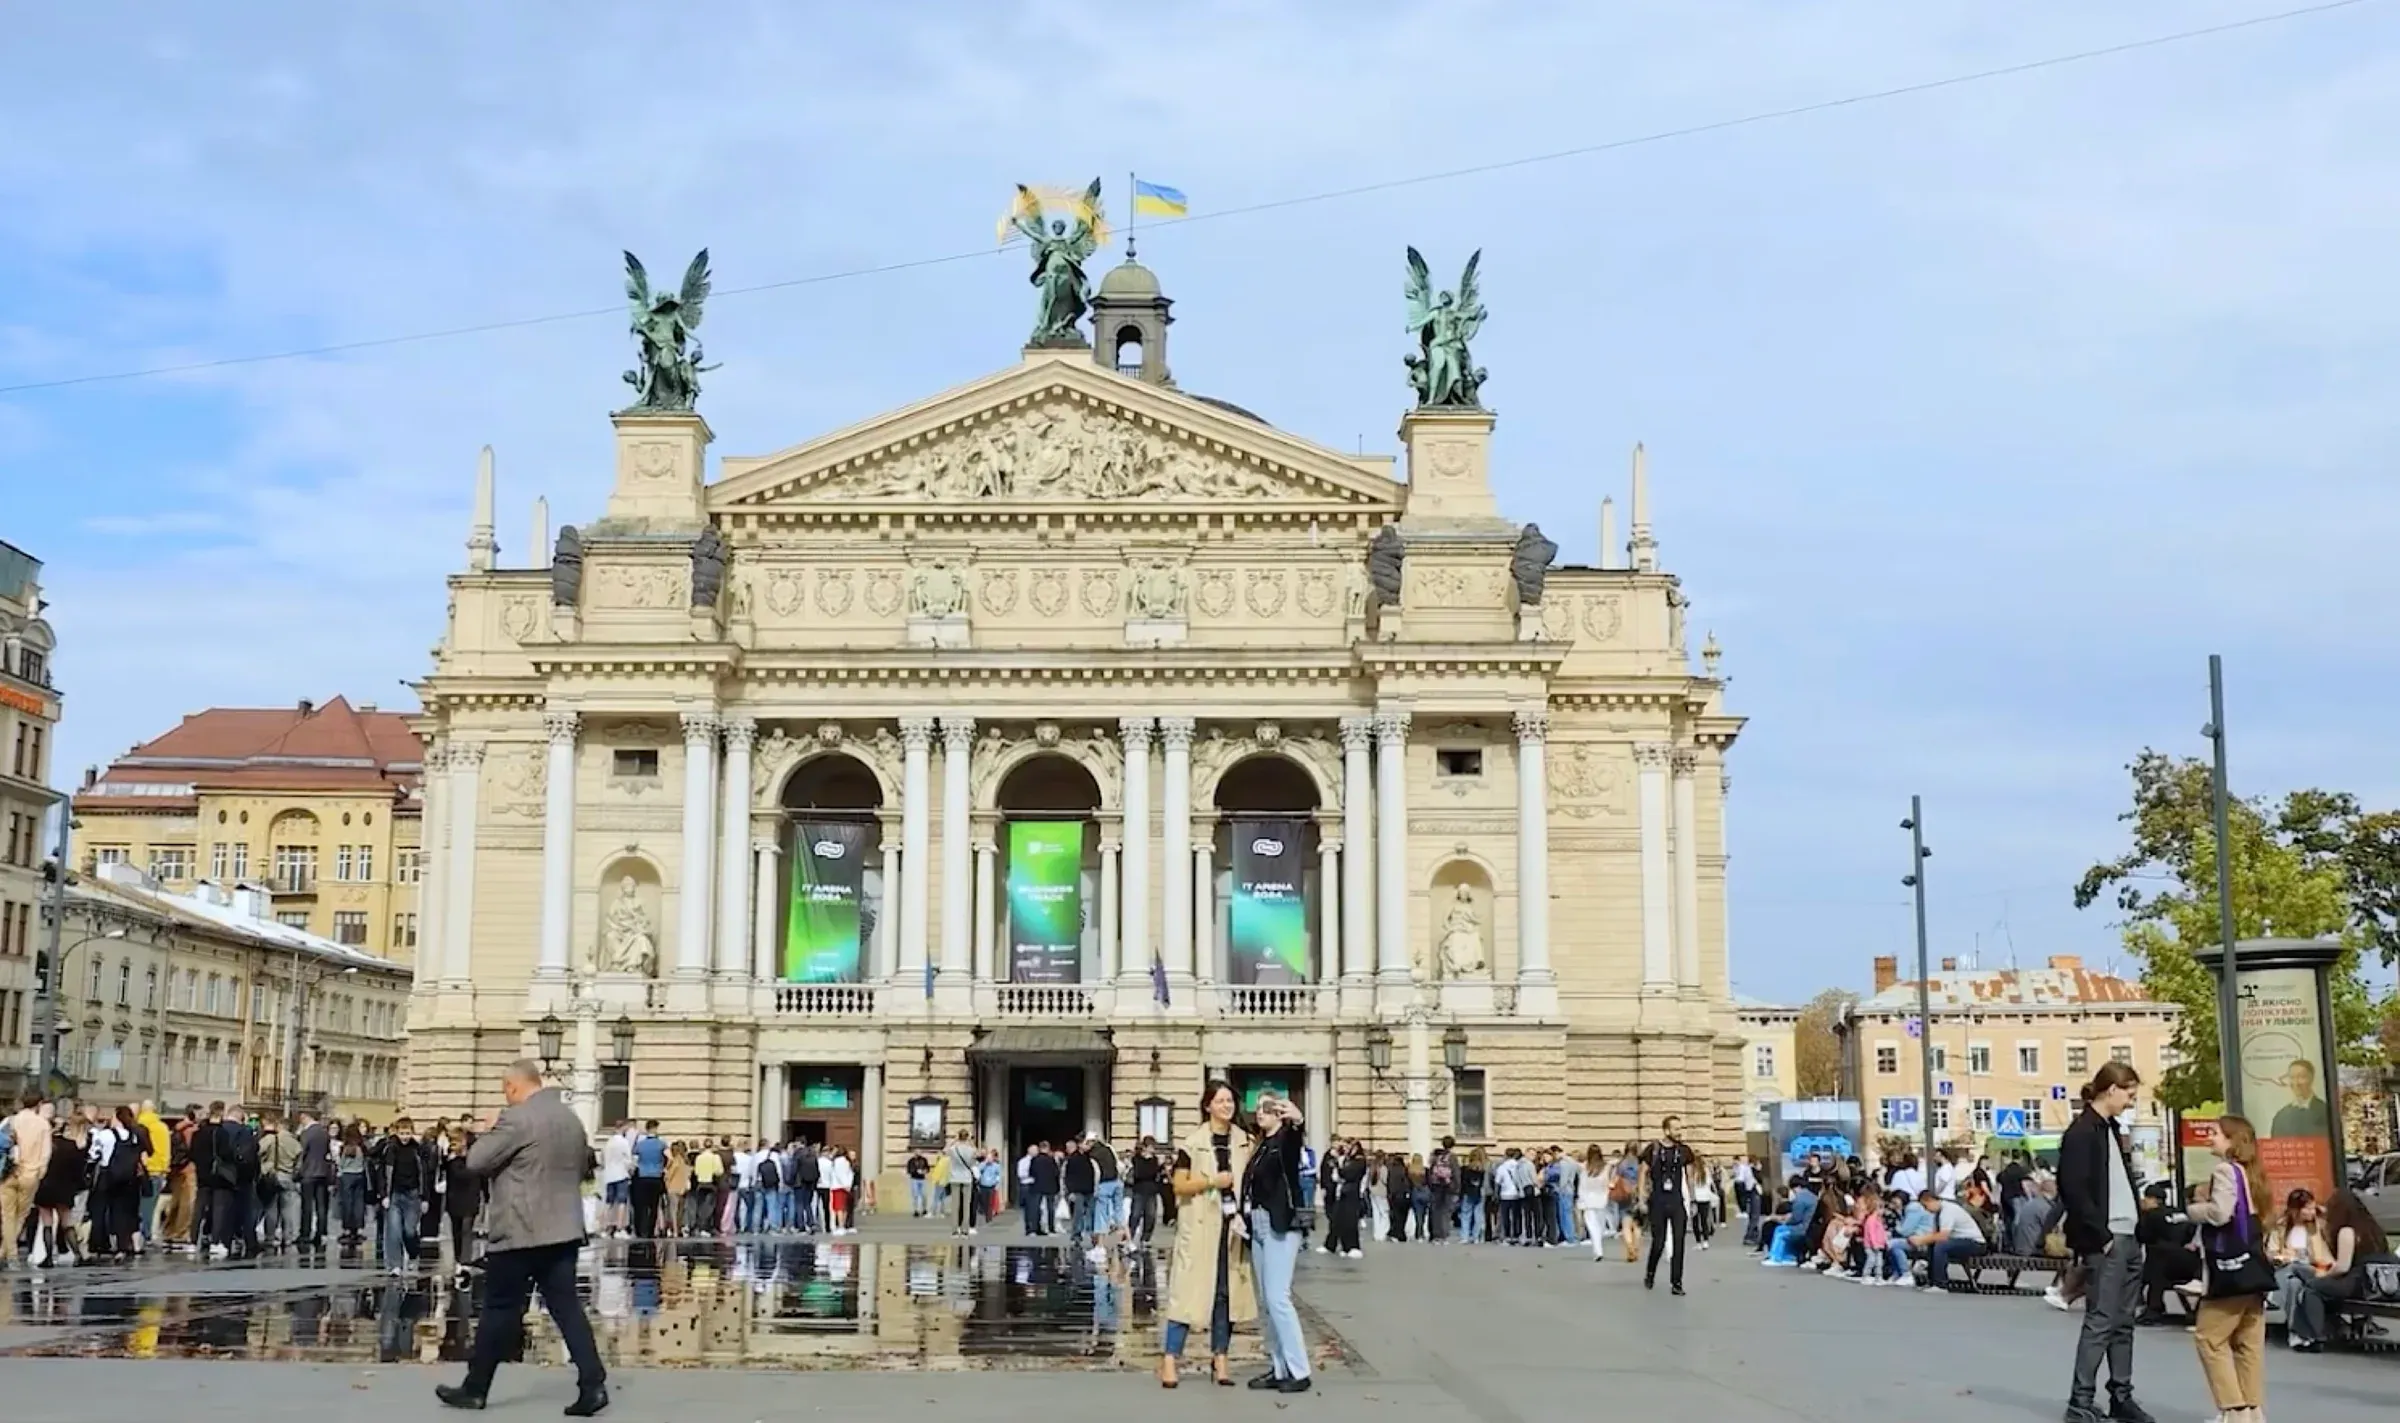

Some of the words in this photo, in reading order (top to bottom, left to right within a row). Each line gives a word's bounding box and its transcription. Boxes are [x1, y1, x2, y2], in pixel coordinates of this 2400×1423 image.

[801, 883, 813, 892] IT
[813, 884, 853, 895] ARENA
[1242, 882, 1253, 891] IT
[1253, 883, 1294, 892] ARENA
[1900, 1100, 1914, 1120] P
